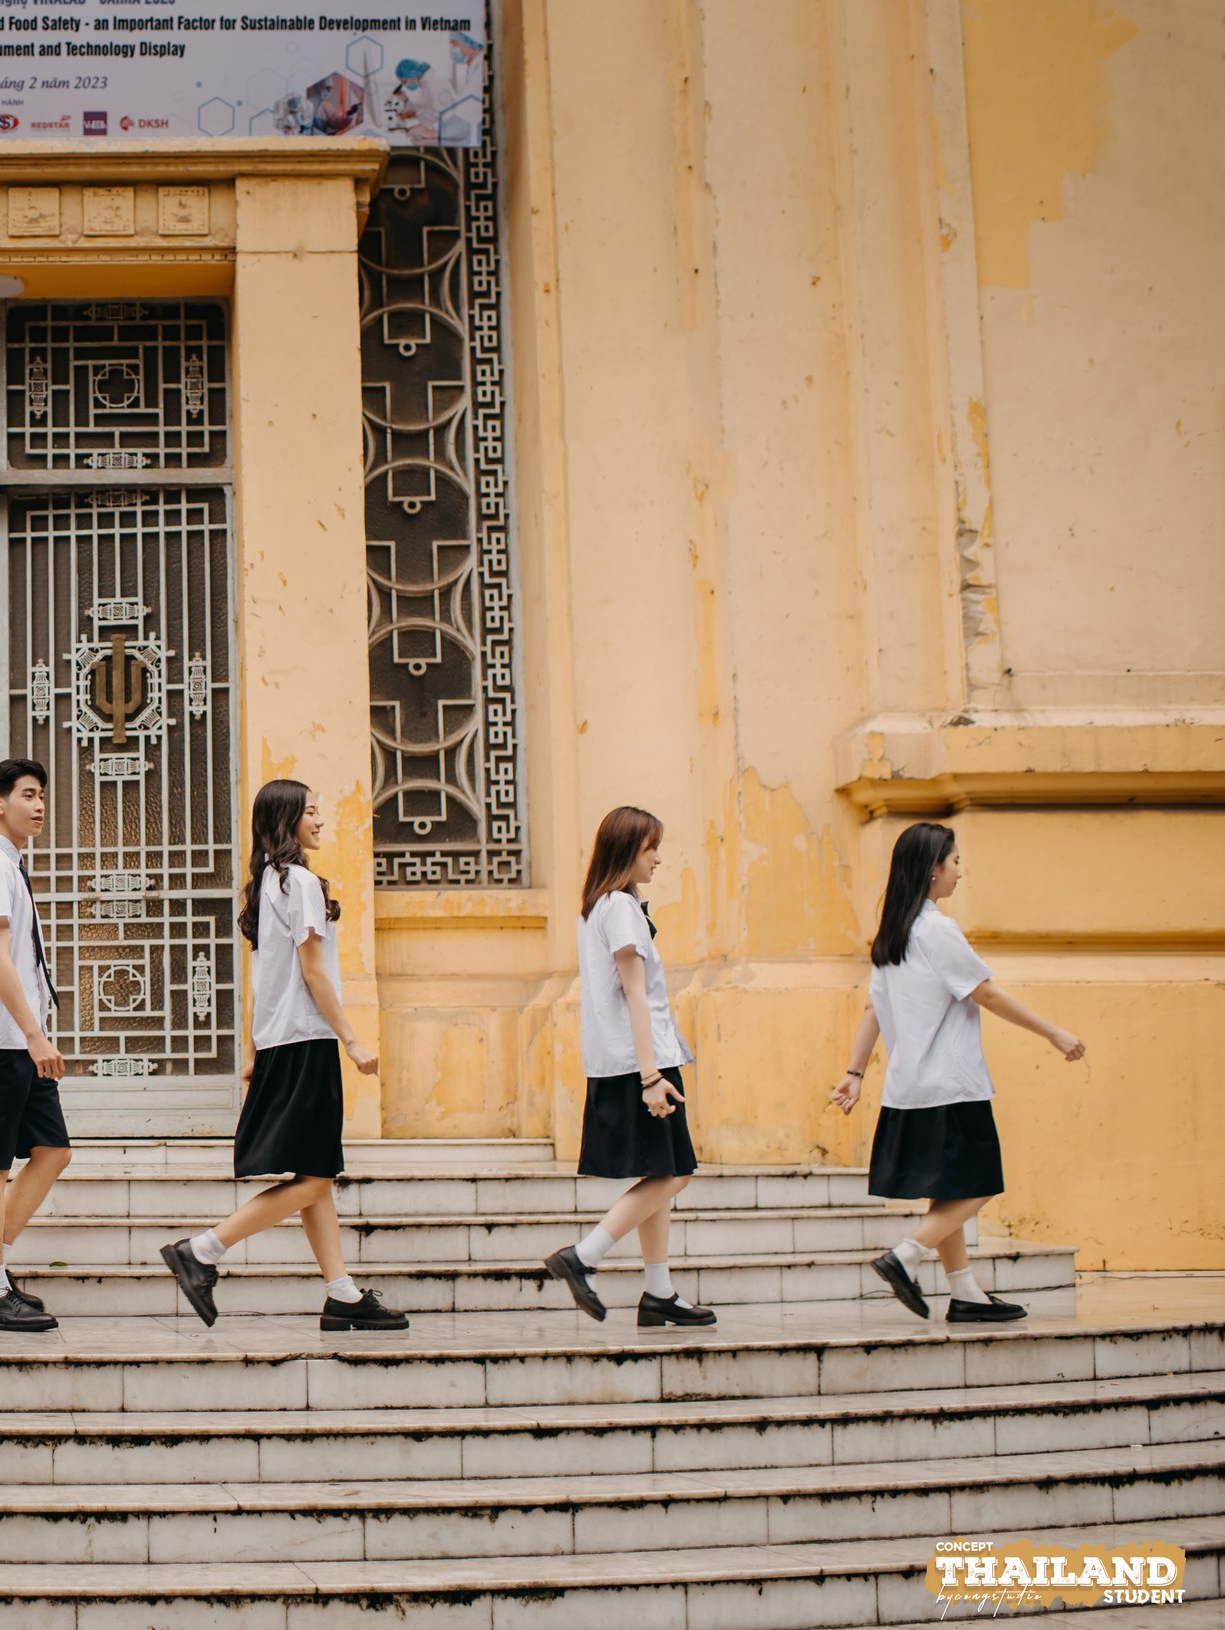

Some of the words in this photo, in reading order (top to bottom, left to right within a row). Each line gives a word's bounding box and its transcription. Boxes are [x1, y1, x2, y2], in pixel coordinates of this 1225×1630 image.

[9, 16, 38, 31] Food
[42, 16, 81, 33] Safety
[94, 19, 109, 31] an
[113, 16, 174, 34] Important
[177, 15, 216, 31] Factor
[219, 15, 237, 31] for
[241, 15, 315, 31] Sustainable
[319, 16, 401, 34] Development
[405, 16, 417, 31] in
[420, 16, 471, 32] Vietnam
[39, 41, 61, 57] and
[65, 41, 136, 60] Technology
[139, 40, 186, 60] Display
[29, 77, 38, 90] 2
[41, 76, 69, 89] năm
[74, 76, 108, 90] 2023
[138, 118, 169, 129] DKSH
